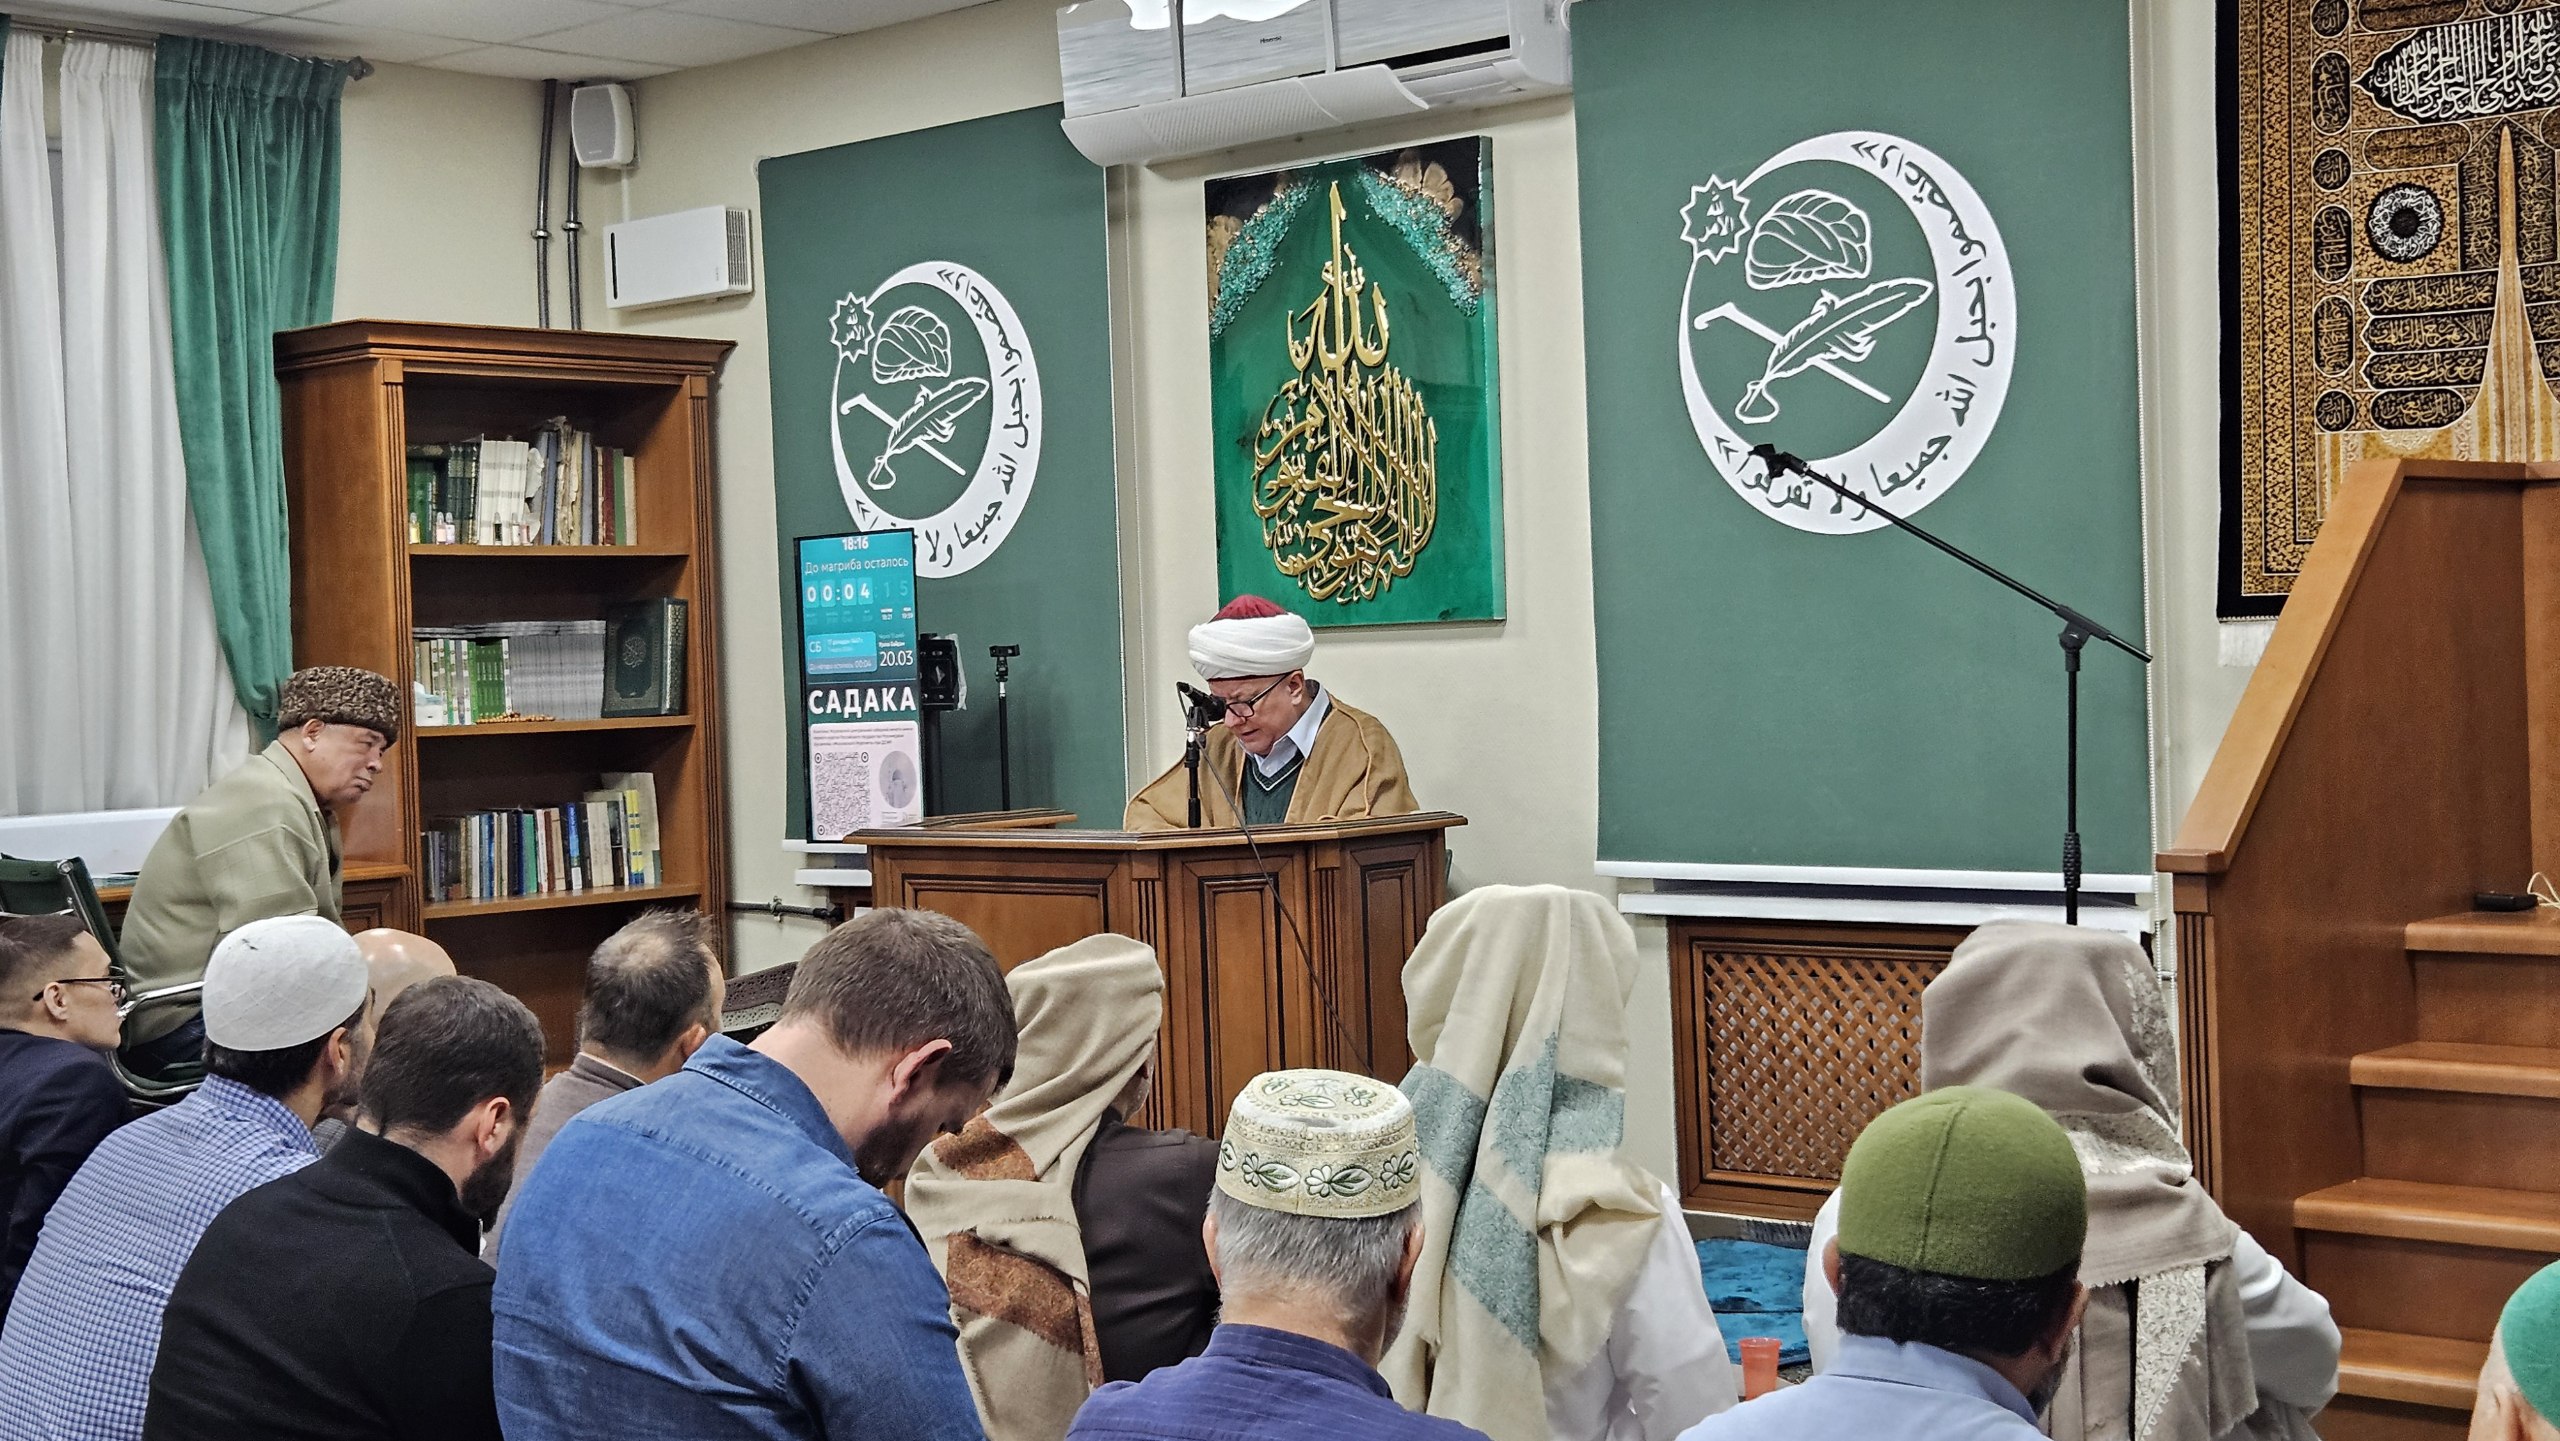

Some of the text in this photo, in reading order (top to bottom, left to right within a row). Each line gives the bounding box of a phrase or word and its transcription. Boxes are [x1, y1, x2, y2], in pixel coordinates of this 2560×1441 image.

[1935, 373, 1978, 427] الله
[992, 453, 1019, 495] الله
[842, 536, 869, 551] 18:16
[804, 556, 909, 575] До магриба осталось
[880, 650, 914, 667] 20.03
[808, 686, 917, 719] САДАКА
